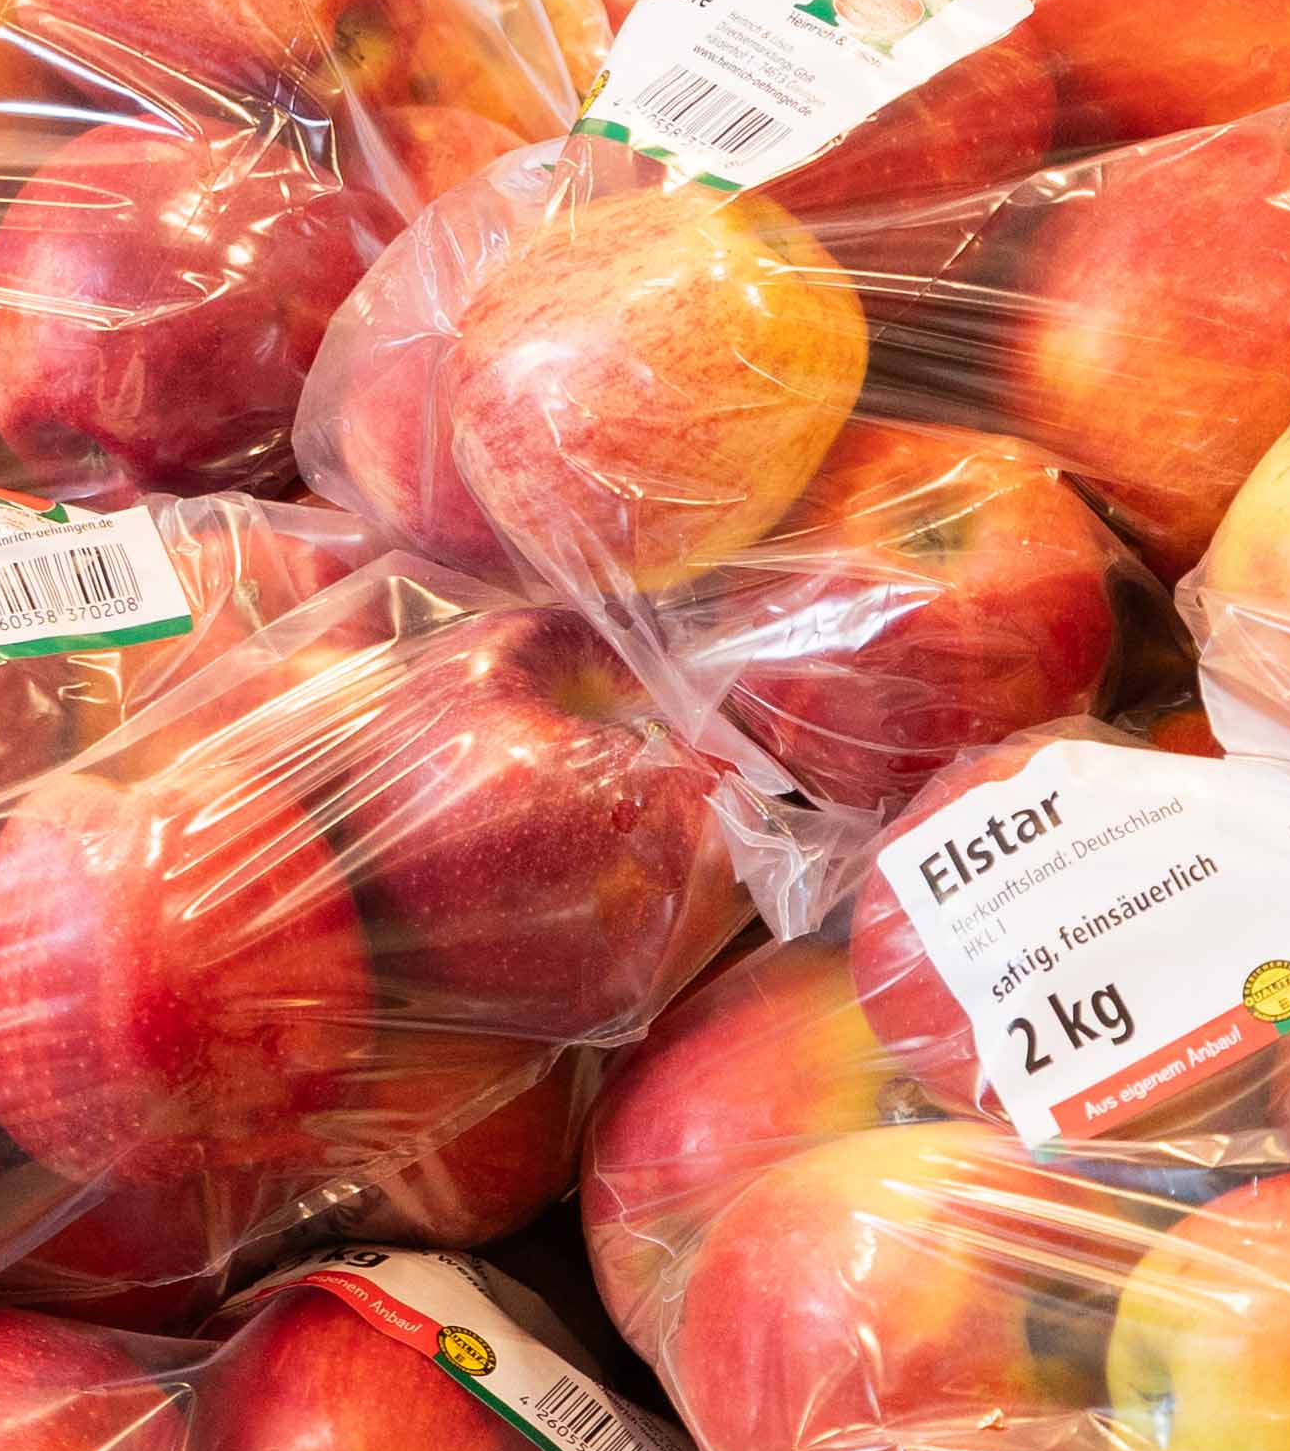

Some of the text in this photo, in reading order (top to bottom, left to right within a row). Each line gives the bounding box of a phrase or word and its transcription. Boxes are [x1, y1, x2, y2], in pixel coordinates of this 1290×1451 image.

[66, 597, 140, 622] 370208
[918, 790, 1065, 906] Elstar
[950, 796, 1185, 937] Herkunftsland: Deutschland
[963, 929, 1001, 963] HKL
[991, 853, 1219, 1004] saftig, feinsäuerlich
[1006, 982, 1137, 1076] 2 kg
[1083, 1024, 1243, 1121] Aus eigenem Anbau!
[368, 1298, 423, 1334] Anbau!
[518, 1395, 531, 1406] 4
